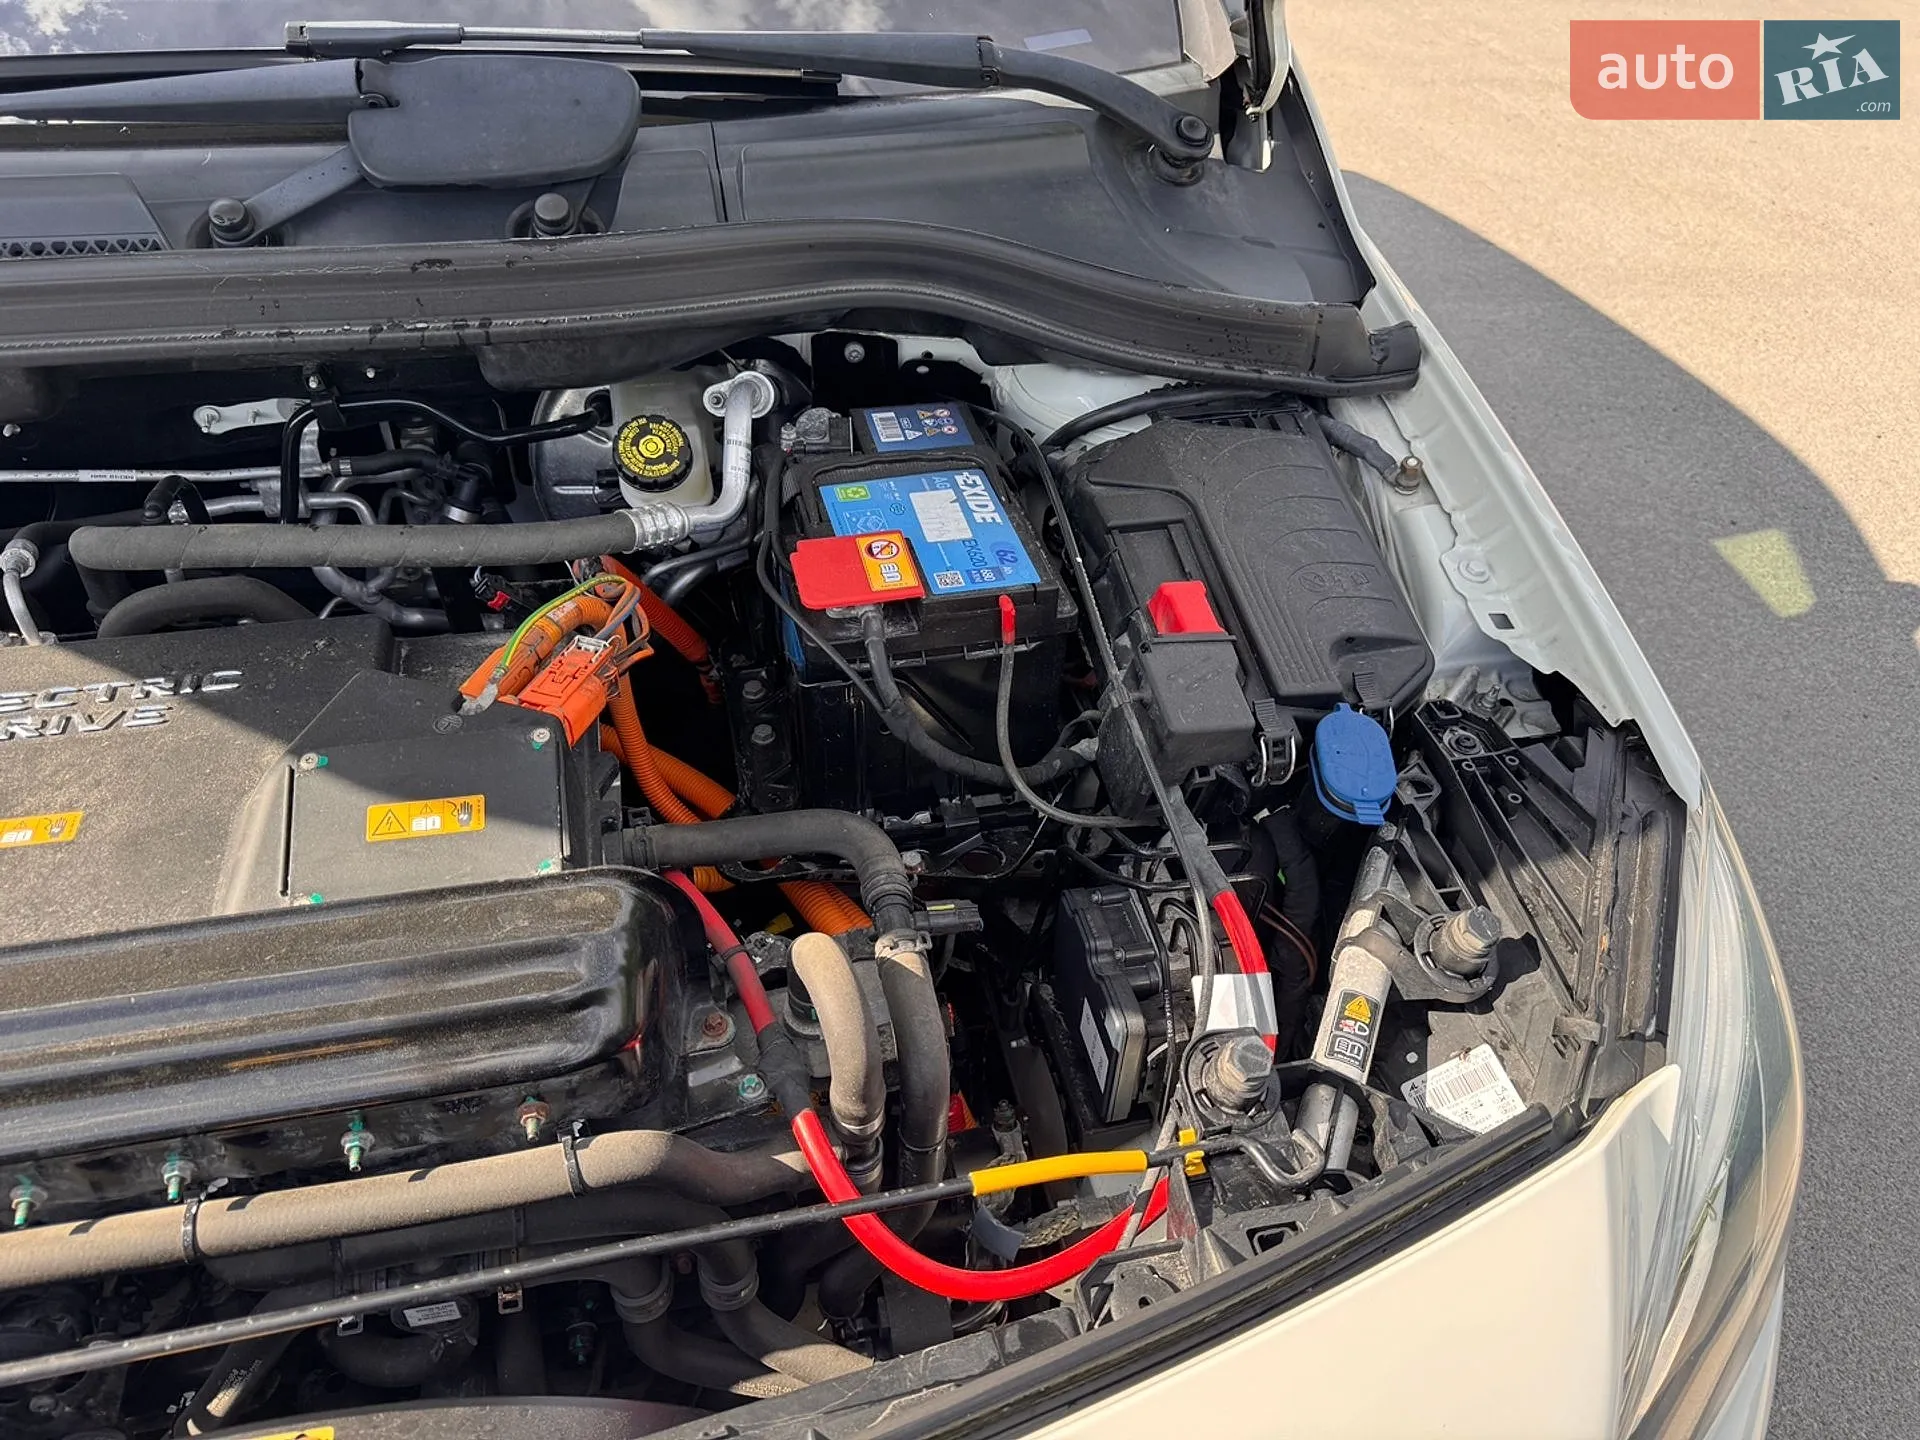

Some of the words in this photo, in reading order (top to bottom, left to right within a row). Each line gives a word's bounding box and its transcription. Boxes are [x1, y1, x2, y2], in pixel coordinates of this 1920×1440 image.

[932, 476, 951, 490] AG
[955, 473, 1002, 524] EXIDE
[963, 539, 987, 567] EK620
[996, 548, 1017, 565] 62
[981, 568, 996, 582] 680
[0, 670, 243, 713] ECTRIC
[0, 706, 174, 740] RIVE
